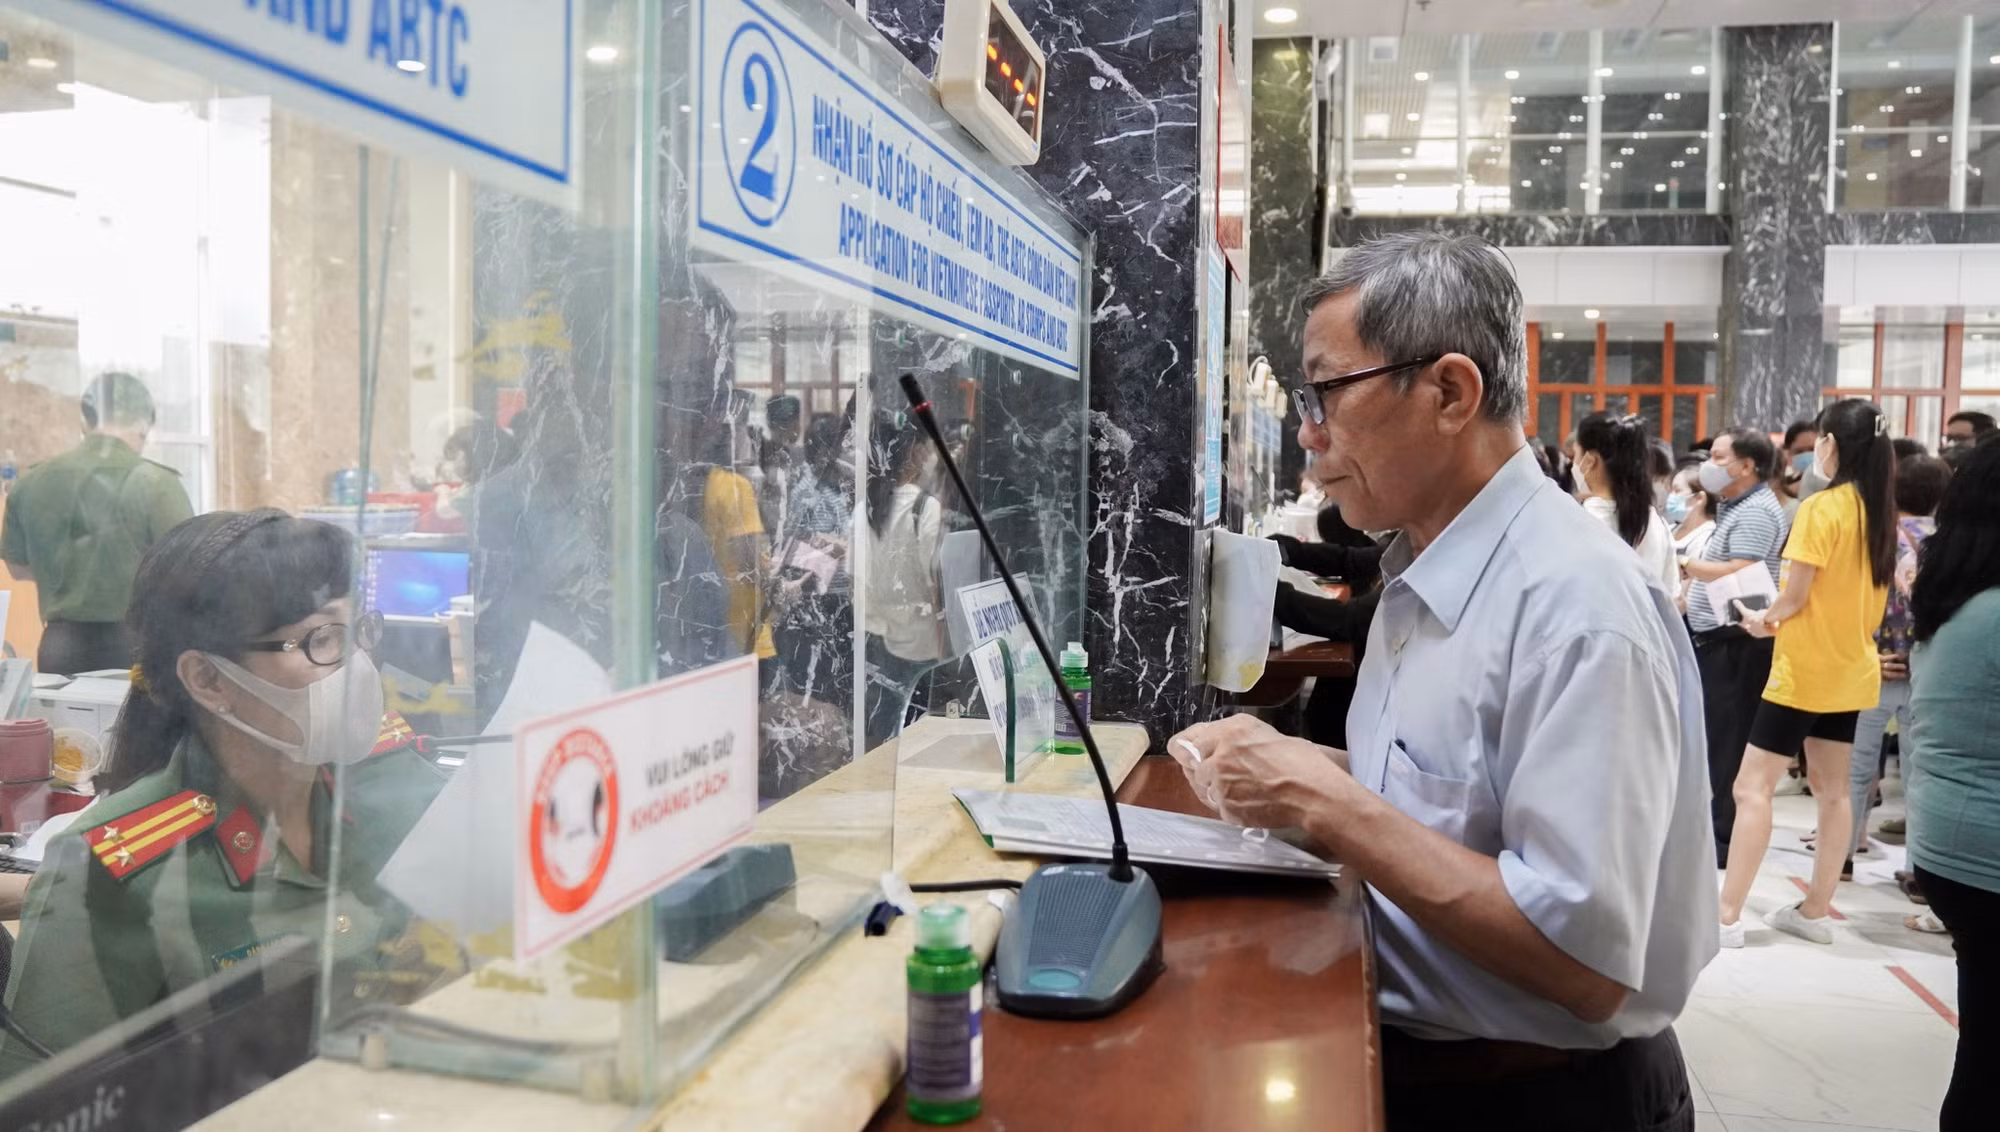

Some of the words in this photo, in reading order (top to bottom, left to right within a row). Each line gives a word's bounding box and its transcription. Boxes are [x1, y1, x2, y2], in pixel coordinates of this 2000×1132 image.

[369, 0, 467, 98] ABTC
[740, 53, 779, 203] 2
[813, 94, 852, 185] NHẬN
[878, 140, 893, 200] SƠ
[966, 203, 982, 255] TEM
[1010, 234, 1026, 282] ABTC
[838, 202, 909, 283] APPLICATION
[912, 240, 928, 291] FOR
[931, 250, 978, 313] VIETNAMESE
[645, 760, 669, 788] VUI
